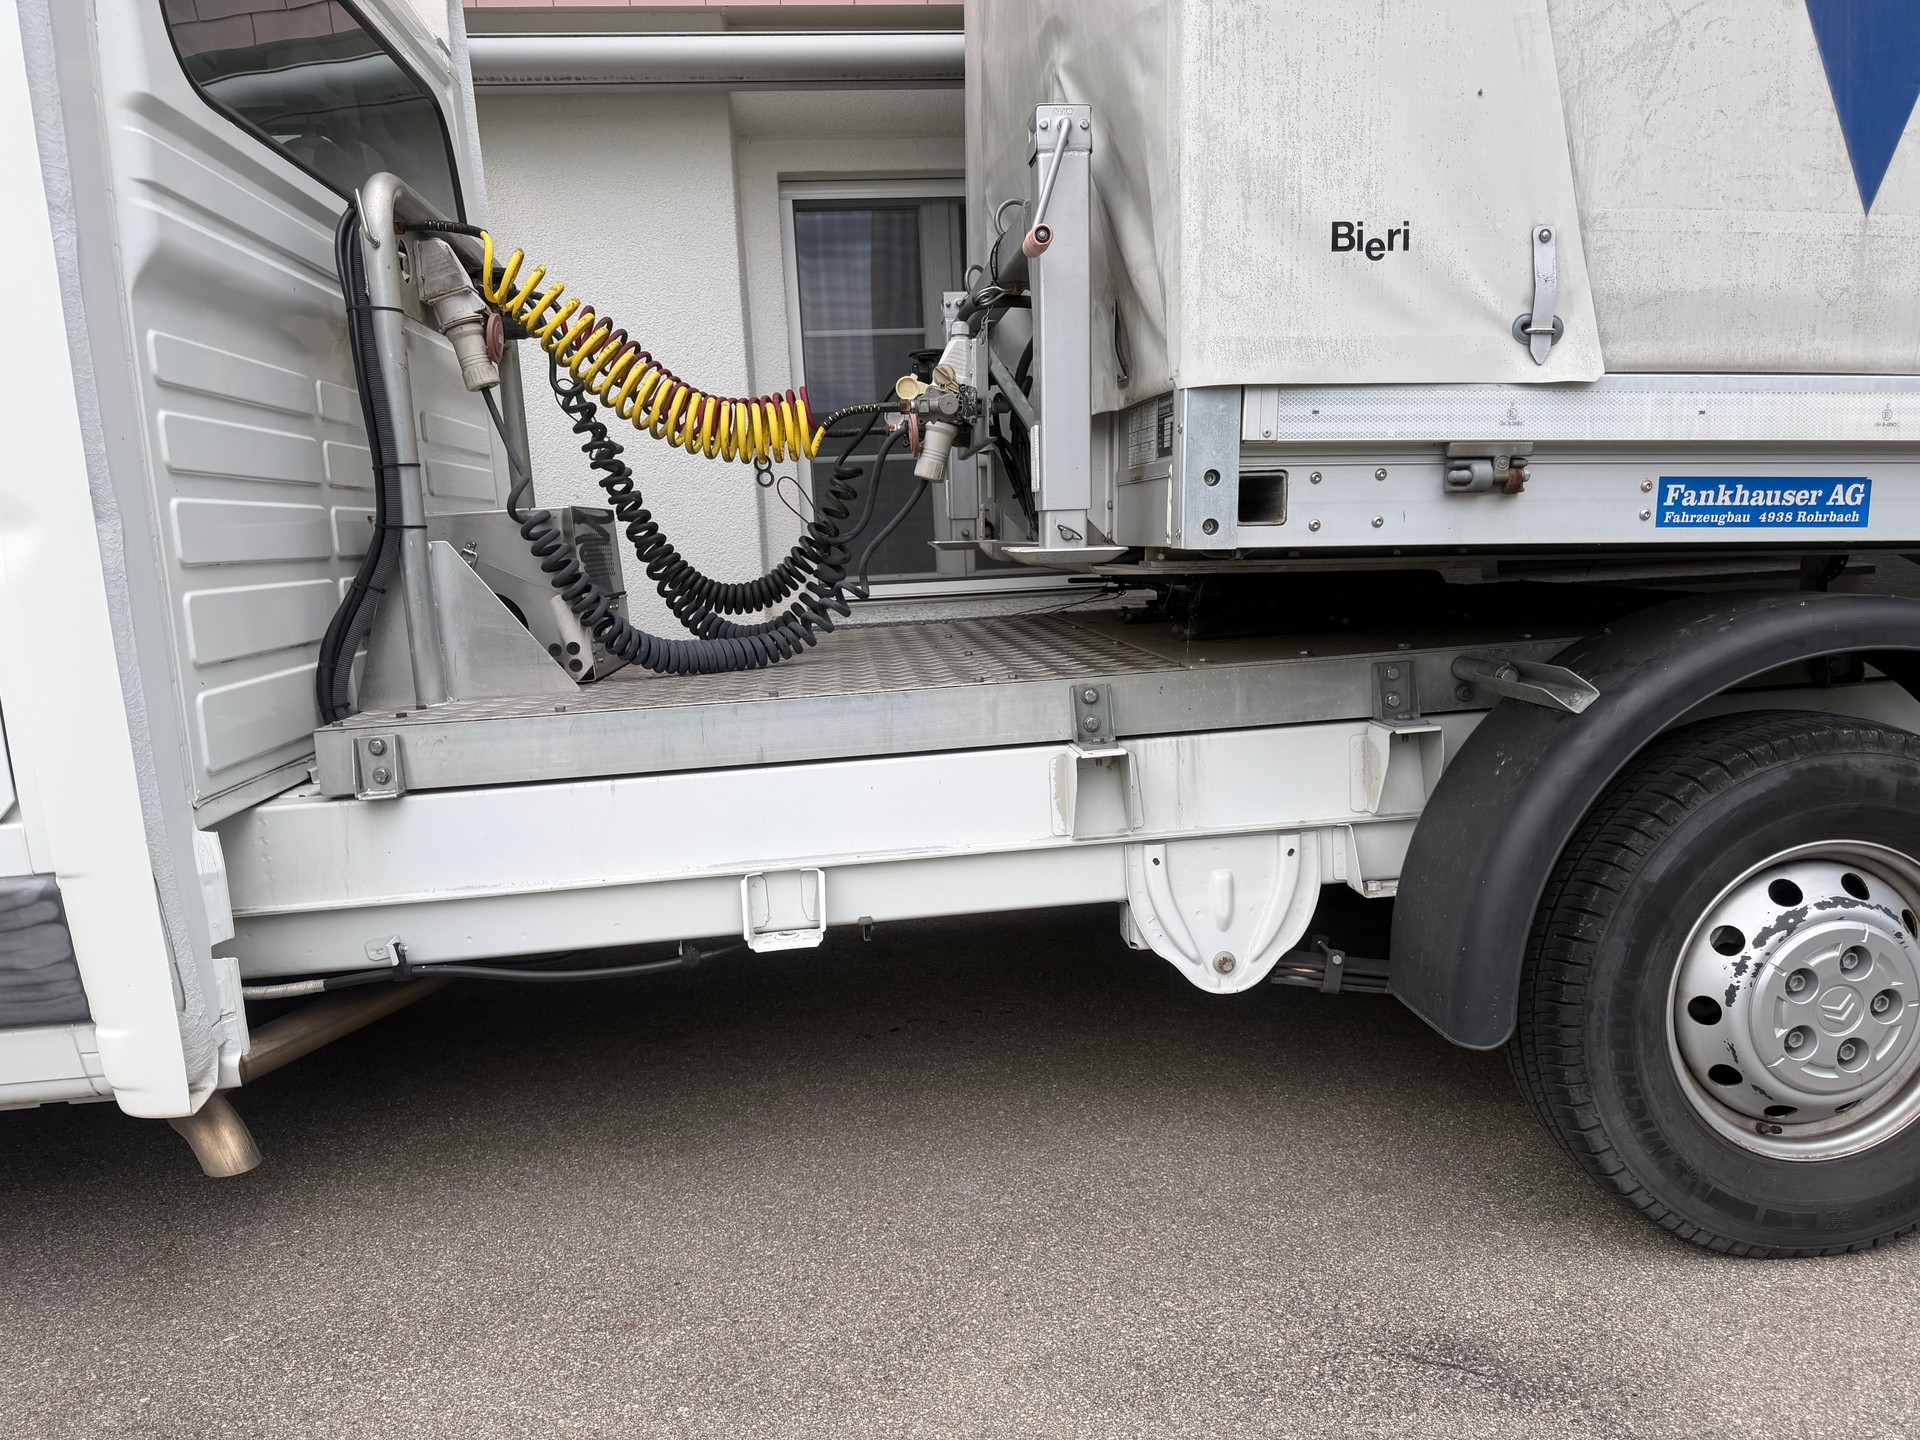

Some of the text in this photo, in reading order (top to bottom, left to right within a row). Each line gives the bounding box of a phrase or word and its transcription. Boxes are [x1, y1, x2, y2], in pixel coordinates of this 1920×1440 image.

[1331, 220, 1410, 261] Bieri
[1663, 483, 1865, 506] Fankhauser AG
[1663, 511, 1860, 526] Fahrzeugbau 4938 Rohrbach
